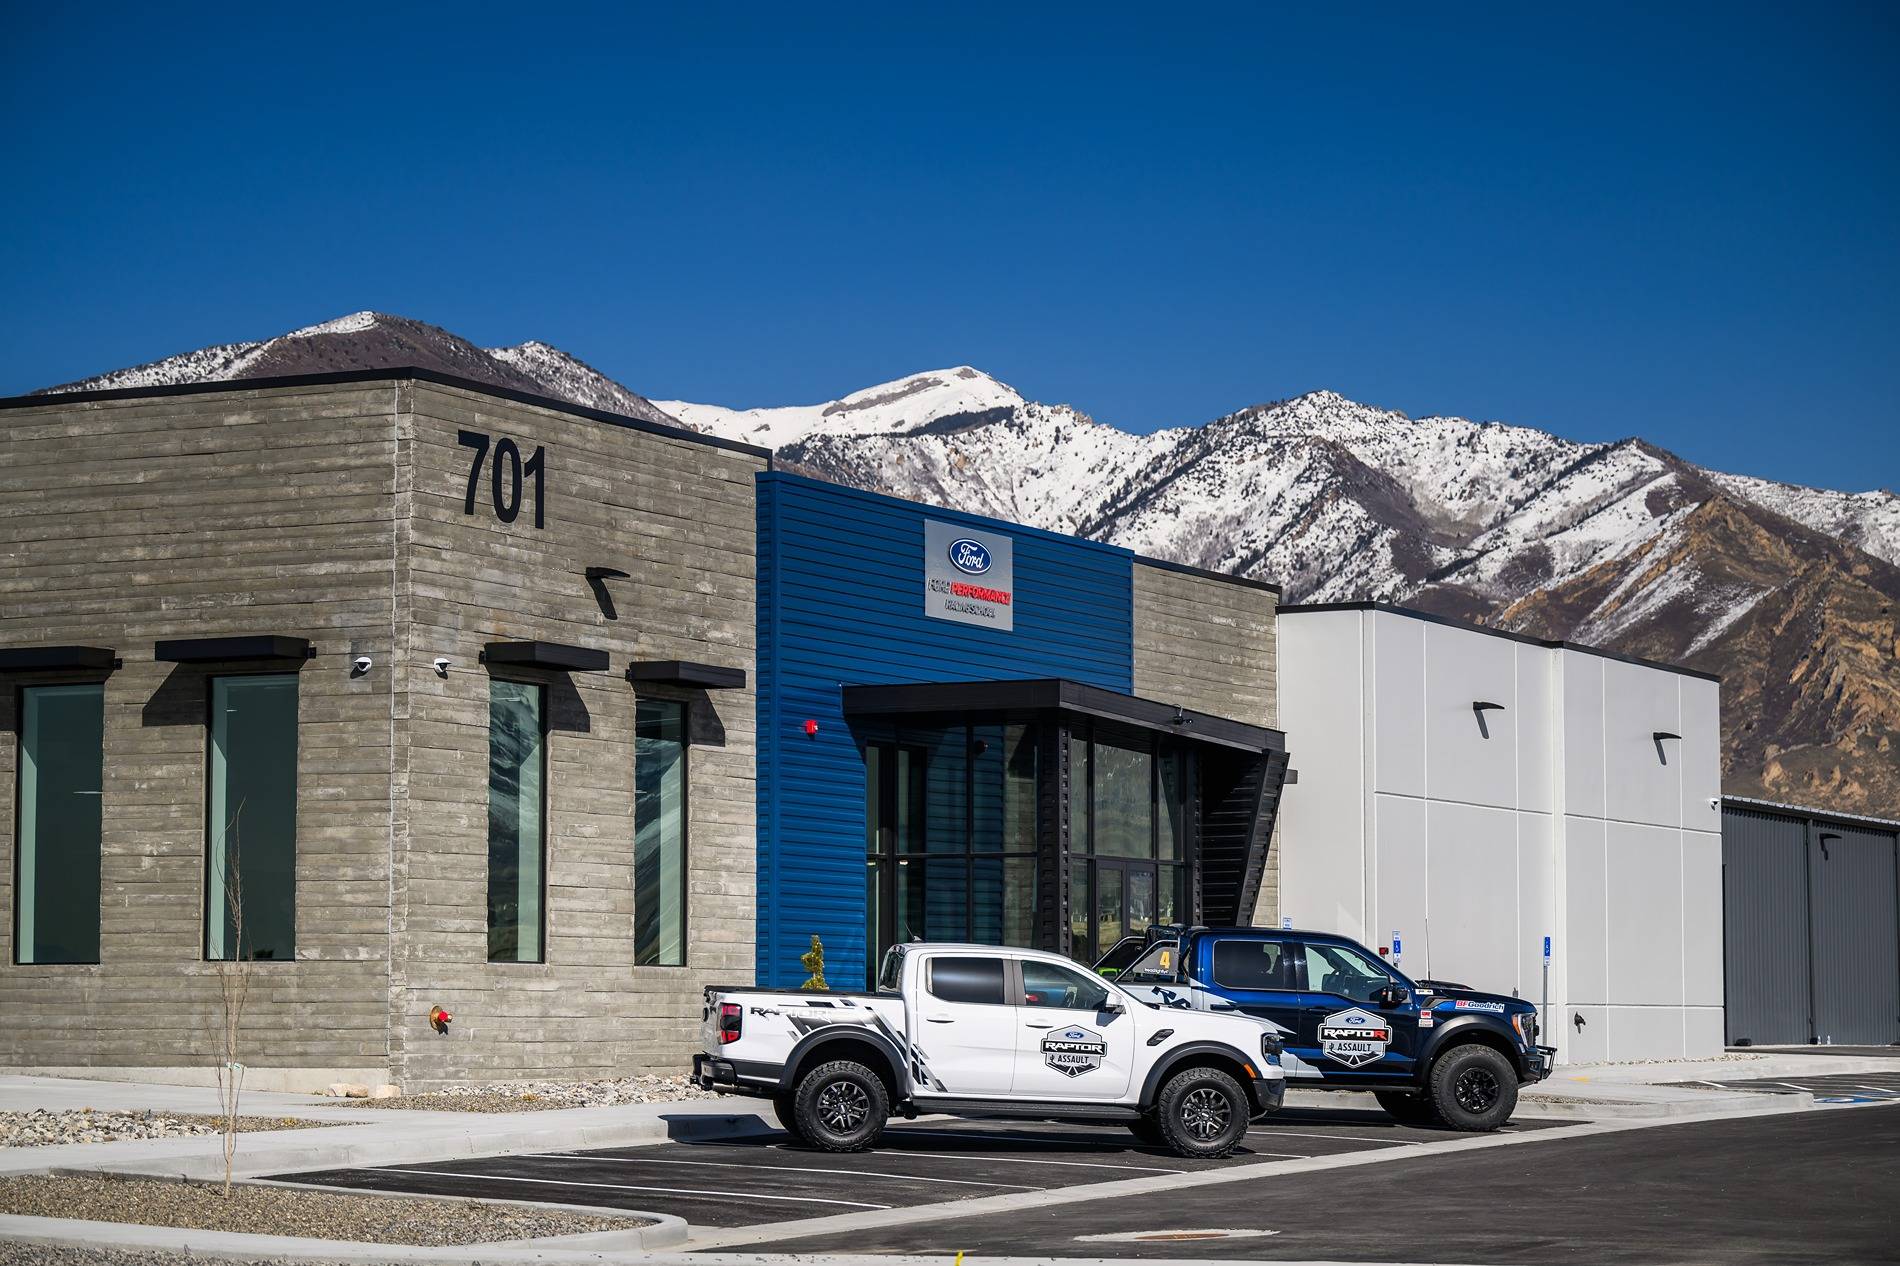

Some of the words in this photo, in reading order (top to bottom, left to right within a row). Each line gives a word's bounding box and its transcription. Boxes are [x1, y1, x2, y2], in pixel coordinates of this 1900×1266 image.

[458, 429, 545, 529] 701
[958, 543, 984, 569] Ford
[1160, 951, 1170, 969] 4
[1456, 1000, 1504, 1010] BFGoodrich
[1323, 1028, 1388, 1041] RAPTOR
[1045, 1042, 1104, 1054] RAPTOR
[1337, 1042, 1372, 1052] ASSAULT
[1057, 1054, 1090, 1064] ASSAULT
